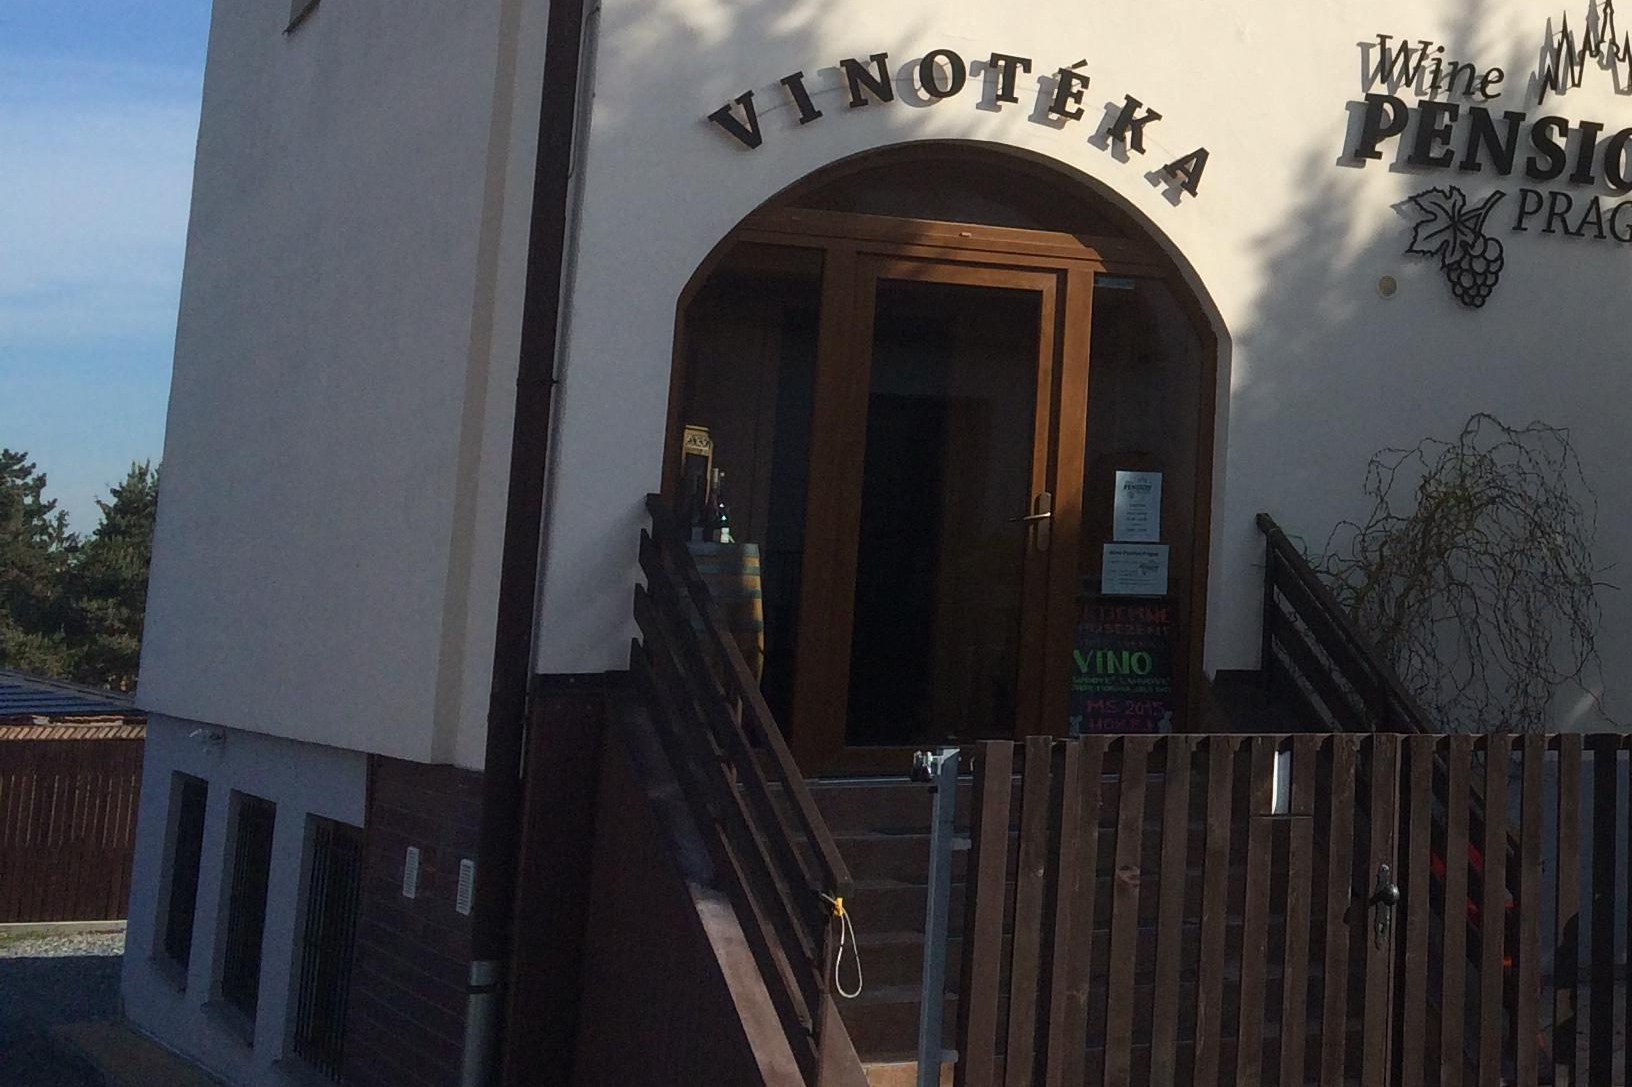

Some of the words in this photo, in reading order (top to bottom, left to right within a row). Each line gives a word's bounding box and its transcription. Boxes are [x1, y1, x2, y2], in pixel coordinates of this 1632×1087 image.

[1376, 34, 1504, 99] Wine
[708, 49, 1209, 198] VINOTÉKA
[1125, 700, 1165, 717] 2015
